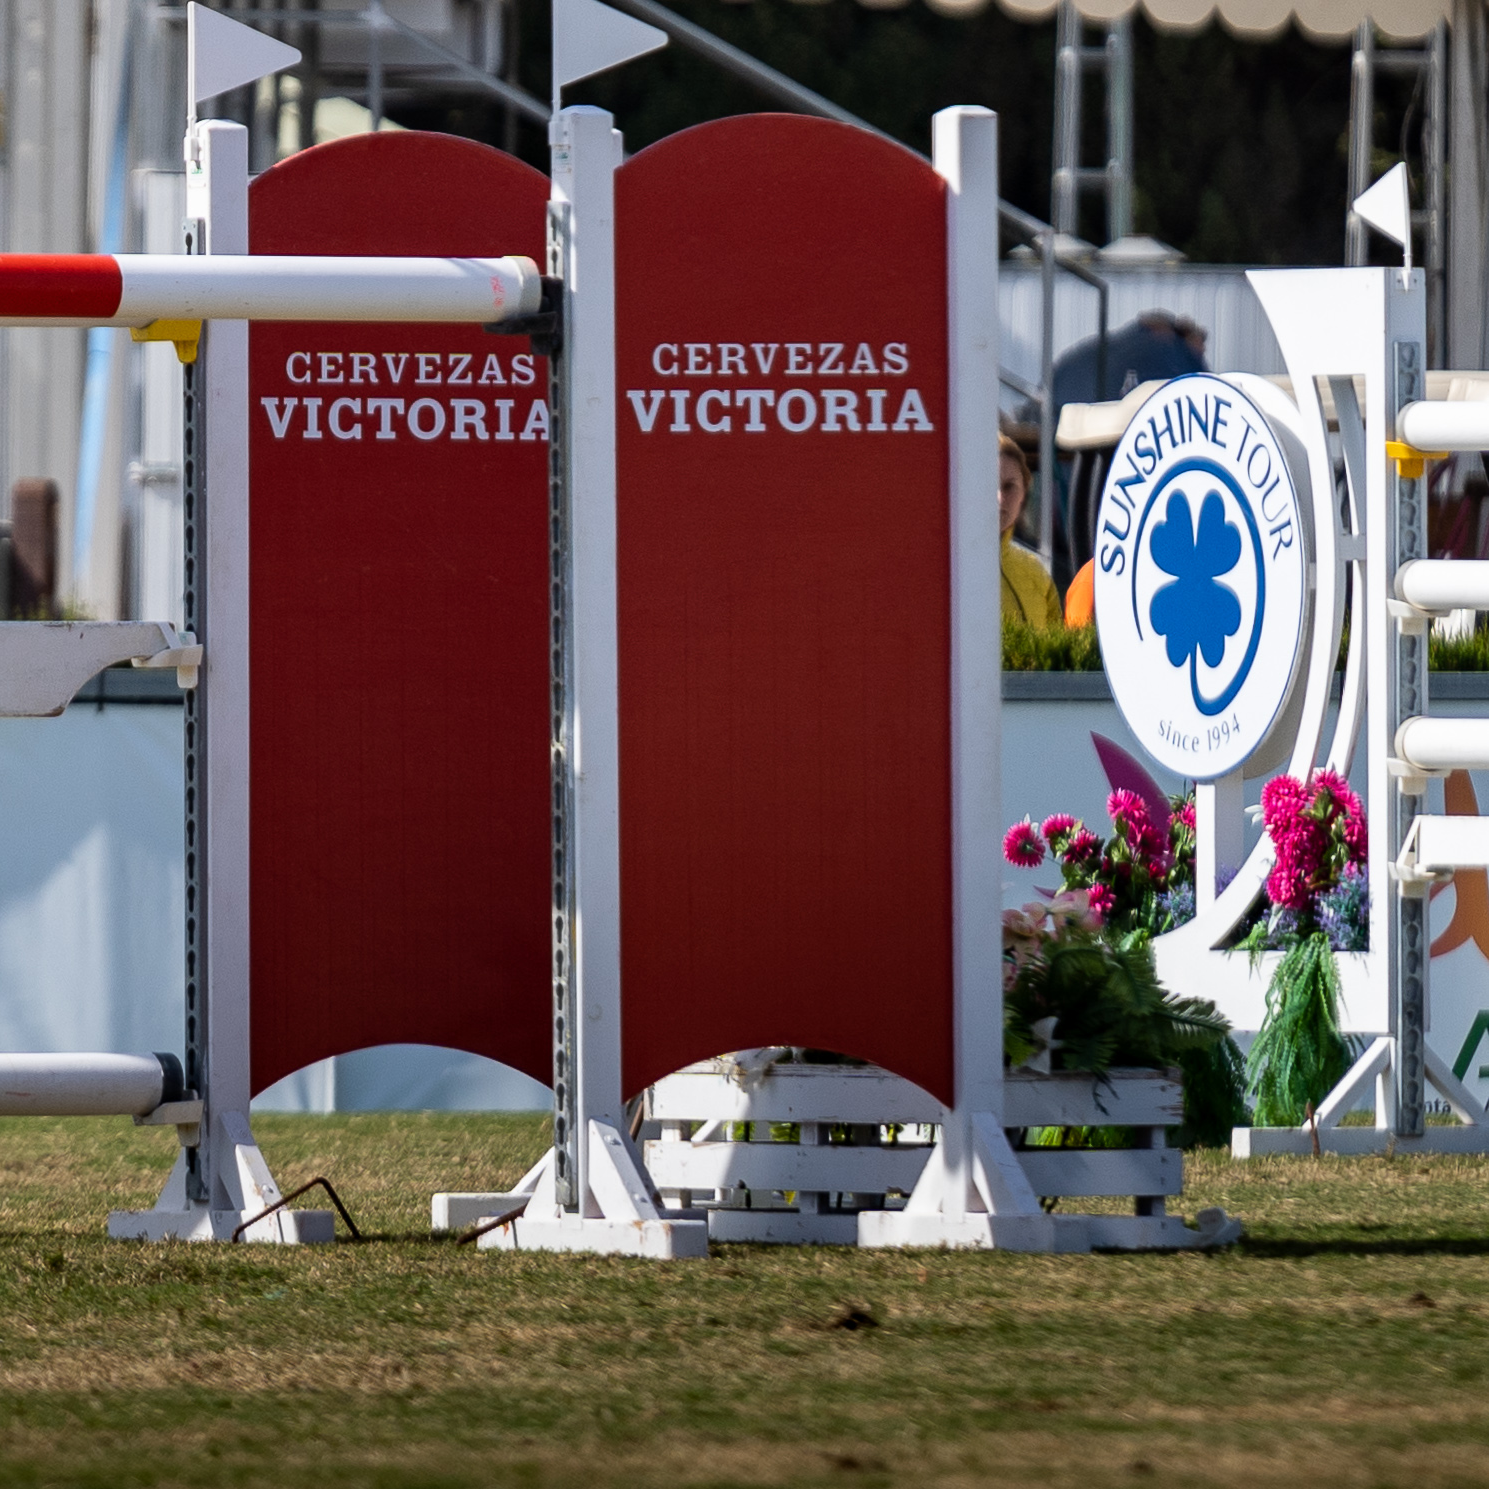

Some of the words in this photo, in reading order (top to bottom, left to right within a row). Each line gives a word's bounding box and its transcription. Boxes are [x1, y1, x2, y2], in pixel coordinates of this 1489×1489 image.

[286, 351, 536, 386] CERVEZAS
[652, 342, 909, 376] CERVEZAS
[260, 396, 550, 441] VICTORIA
[627, 388, 934, 433] VICTORIA
[1100, 393, 1232, 576] SUNSHINE
[1236, 415, 1294, 561] TOUR
[1158, 719, 1200, 753] since
[1207, 712, 1240, 752] 1994
